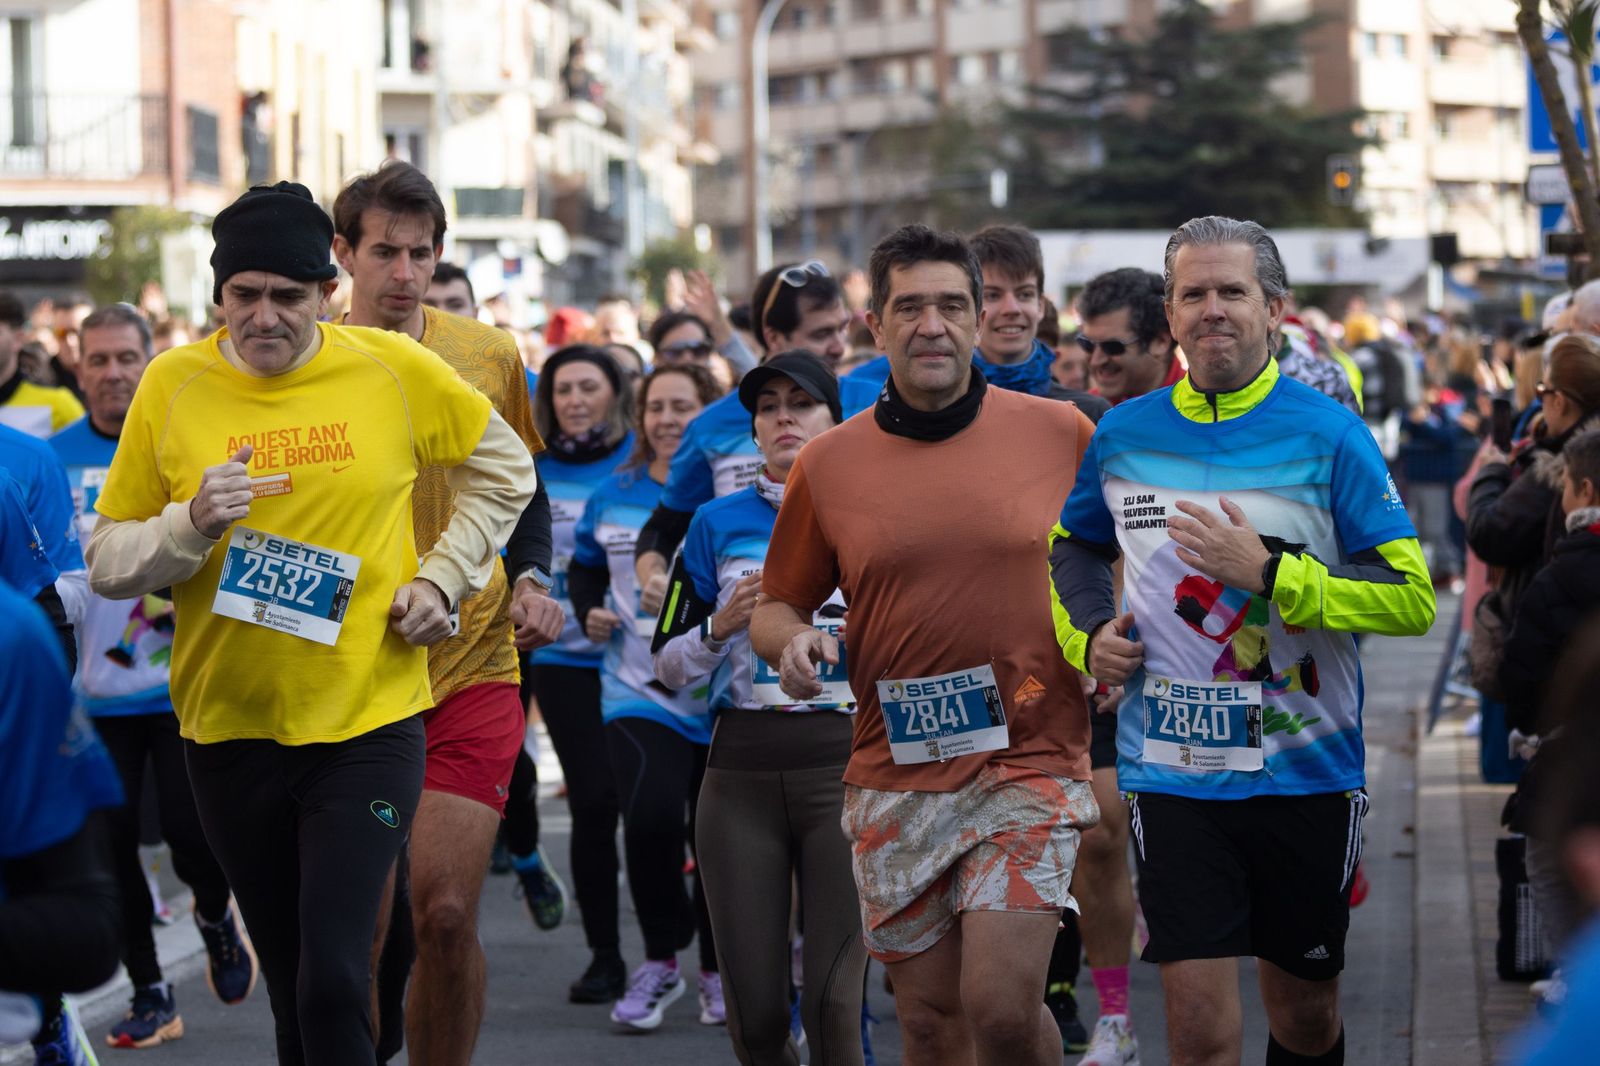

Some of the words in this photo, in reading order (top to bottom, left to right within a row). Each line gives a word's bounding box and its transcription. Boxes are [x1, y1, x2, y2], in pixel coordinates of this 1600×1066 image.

[227, 427, 302, 454] AQUEST
[308, 422, 349, 445] ANY
[254, 451, 279, 471] DE
[285, 442, 355, 468] BROMA
[1123, 496, 1135, 506] XLI
[1136, 494, 1155, 505] SAN
[1123, 506, 1166, 518] SILVESTRE
[265, 538, 345, 573] SETEL
[236, 552, 322, 607] 2532
[906, 674, 982, 698] SETEL
[1171, 683, 1248, 701] SETEL
[901, 694, 970, 736] 2841
[1157, 700, 1231, 741] 2840
[1192, 753, 1226, 761] Ayuntamiento
